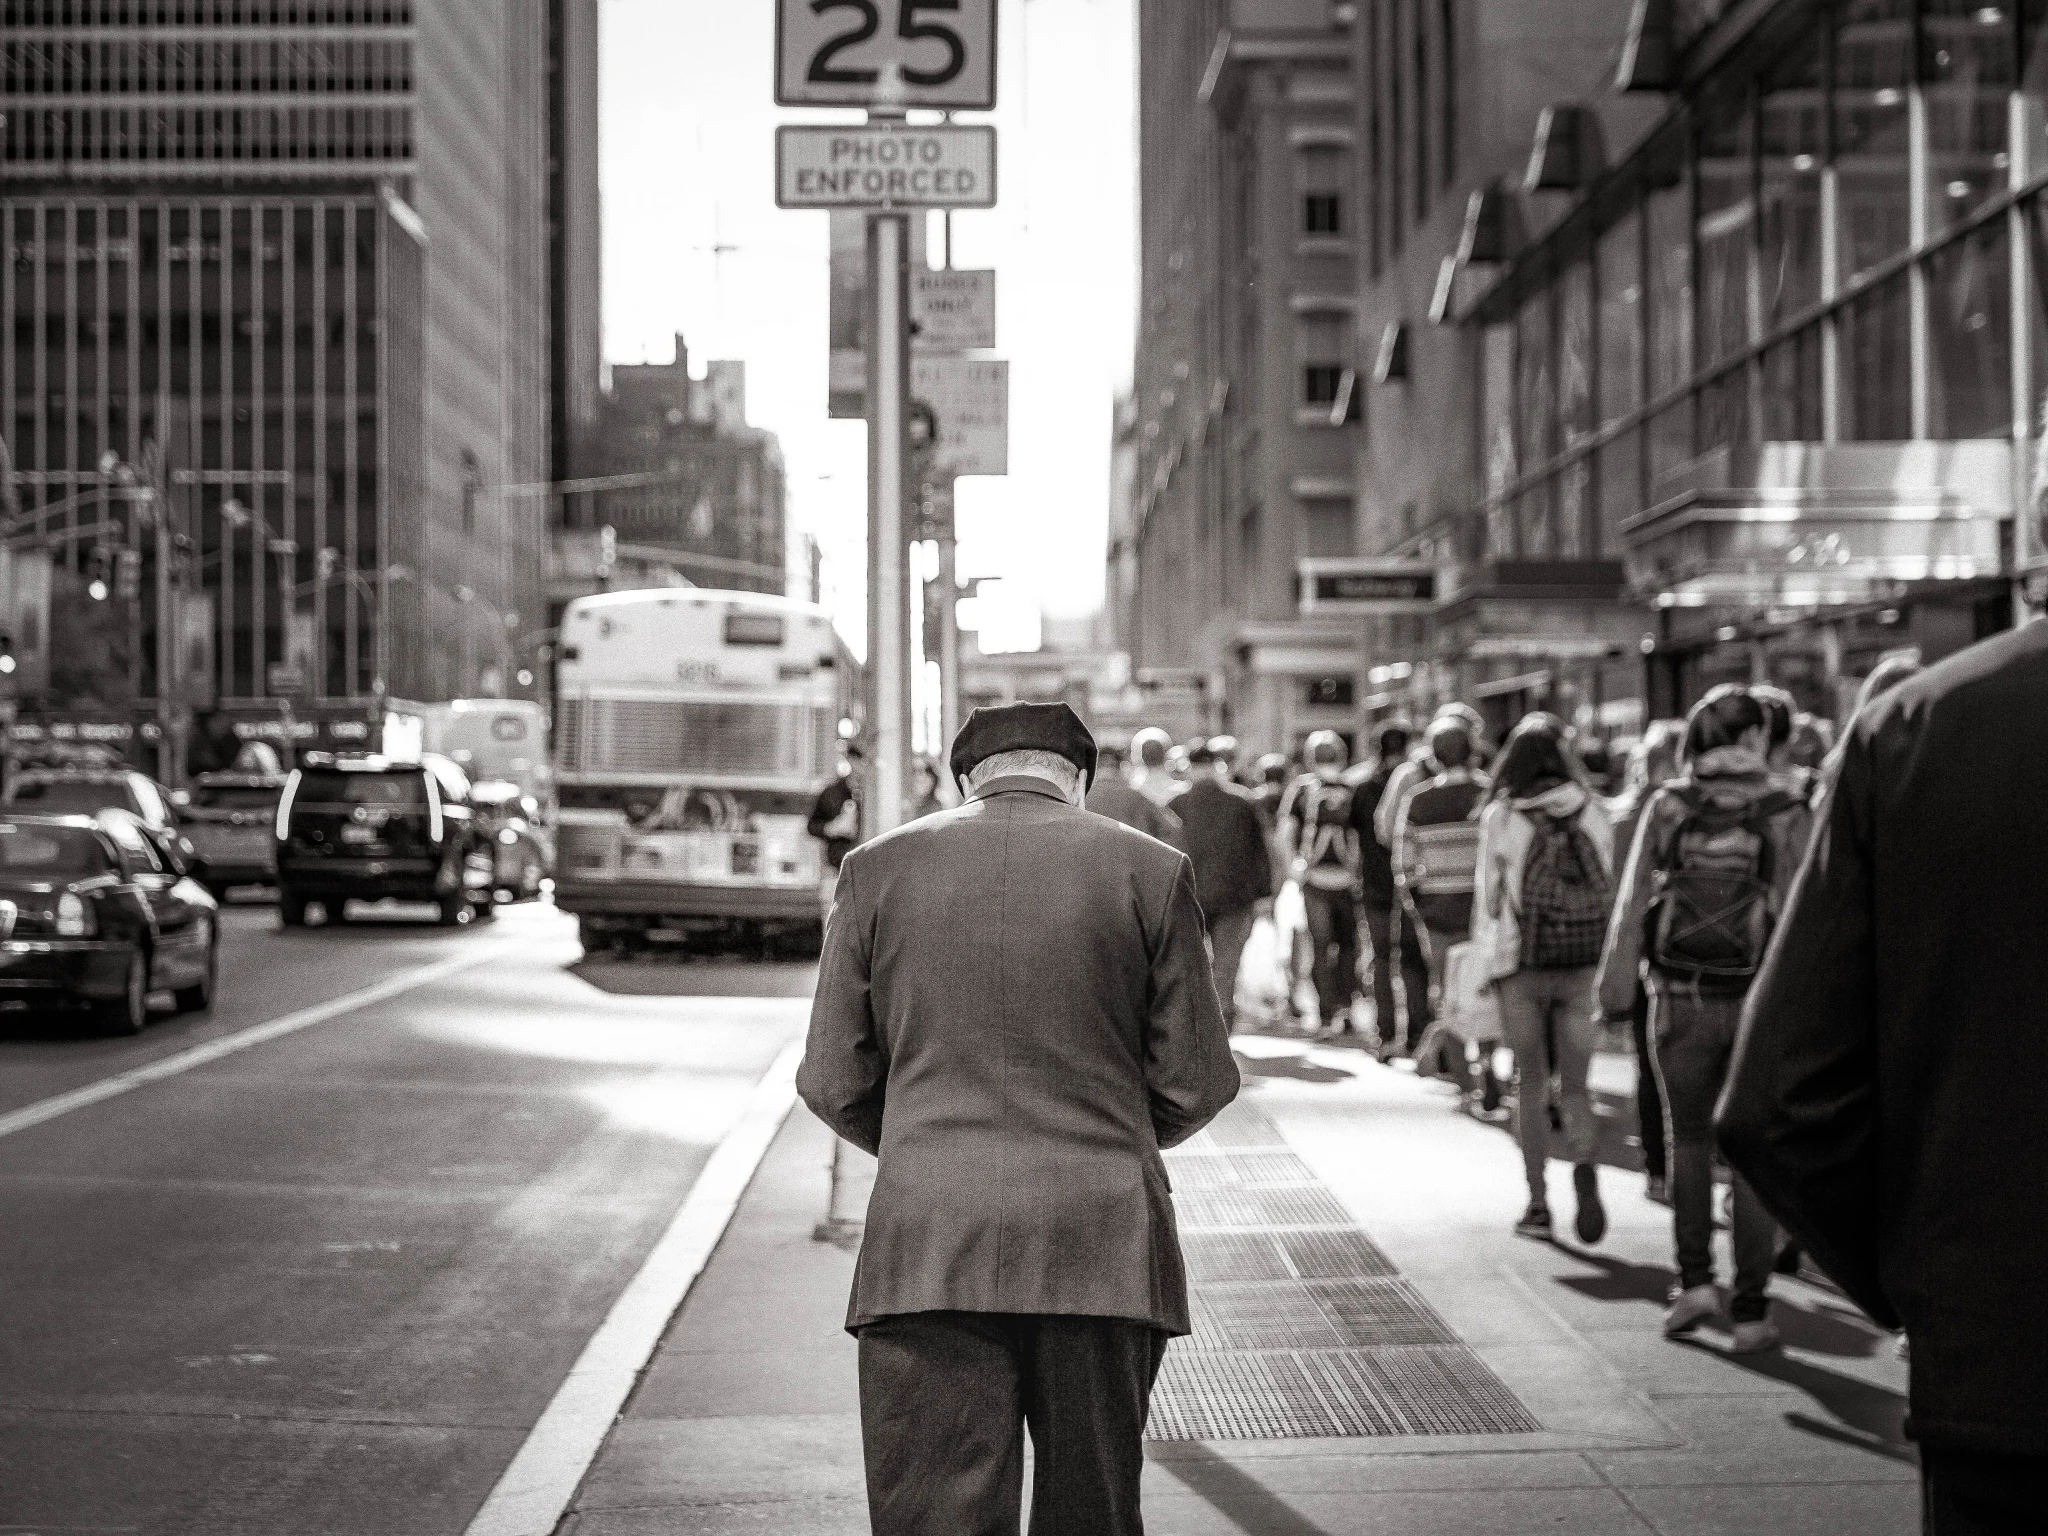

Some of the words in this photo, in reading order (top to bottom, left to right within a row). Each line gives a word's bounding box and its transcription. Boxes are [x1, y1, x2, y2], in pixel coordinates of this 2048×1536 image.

[807, 0, 966, 86] 25
[830, 137, 942, 165] PHOTO
[796, 167, 976, 195] ENFORCED
